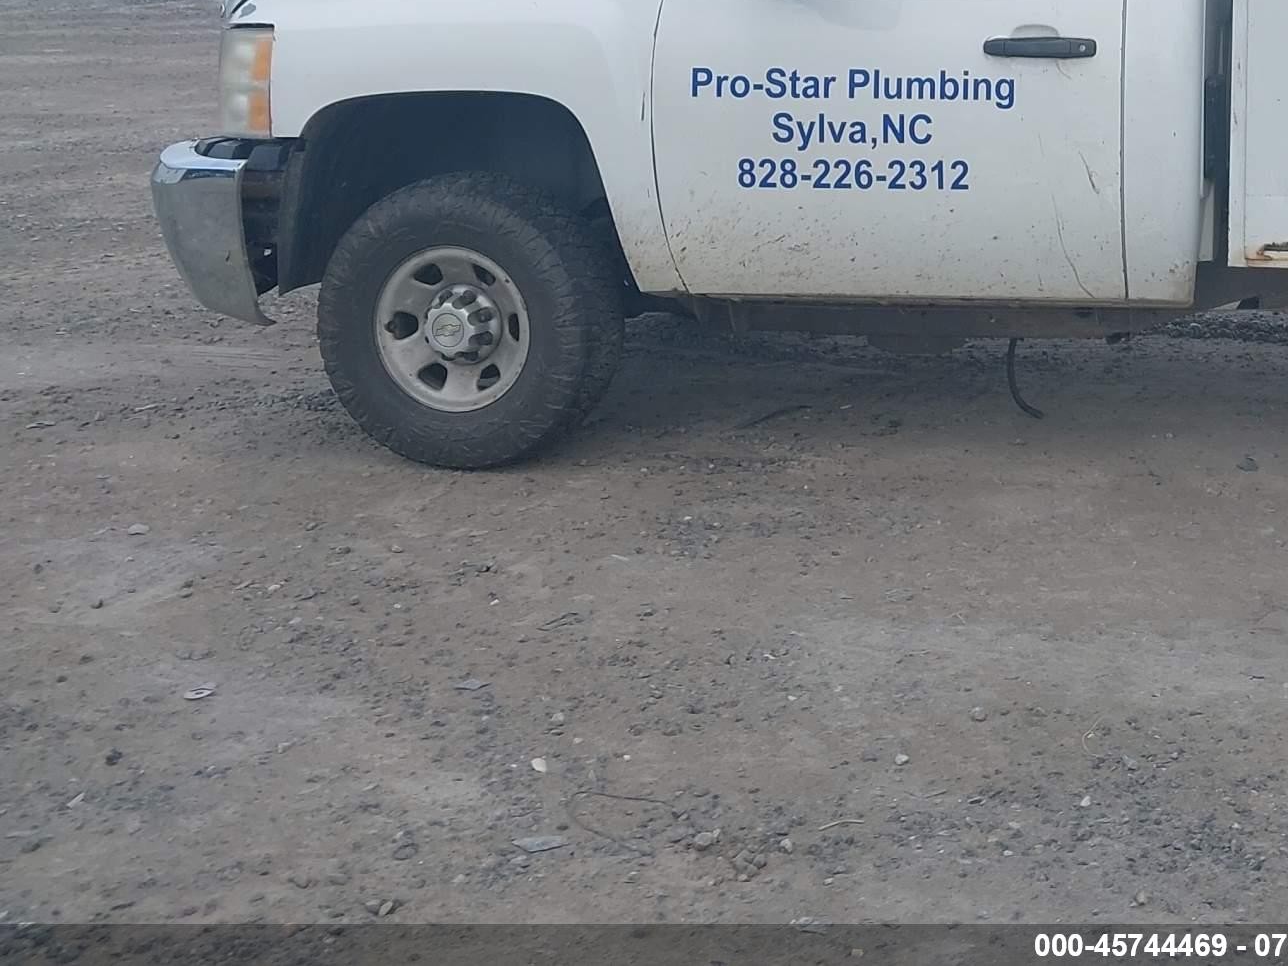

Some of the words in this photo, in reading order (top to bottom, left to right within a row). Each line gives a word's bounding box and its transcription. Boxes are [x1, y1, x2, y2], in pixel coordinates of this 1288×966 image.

[690, 67, 836, 99] Pro-Star
[847, 69, 1015, 109] Plumbing
[772, 112, 932, 150] Sylva,NC
[738, 158, 969, 191] 828-226-2312
